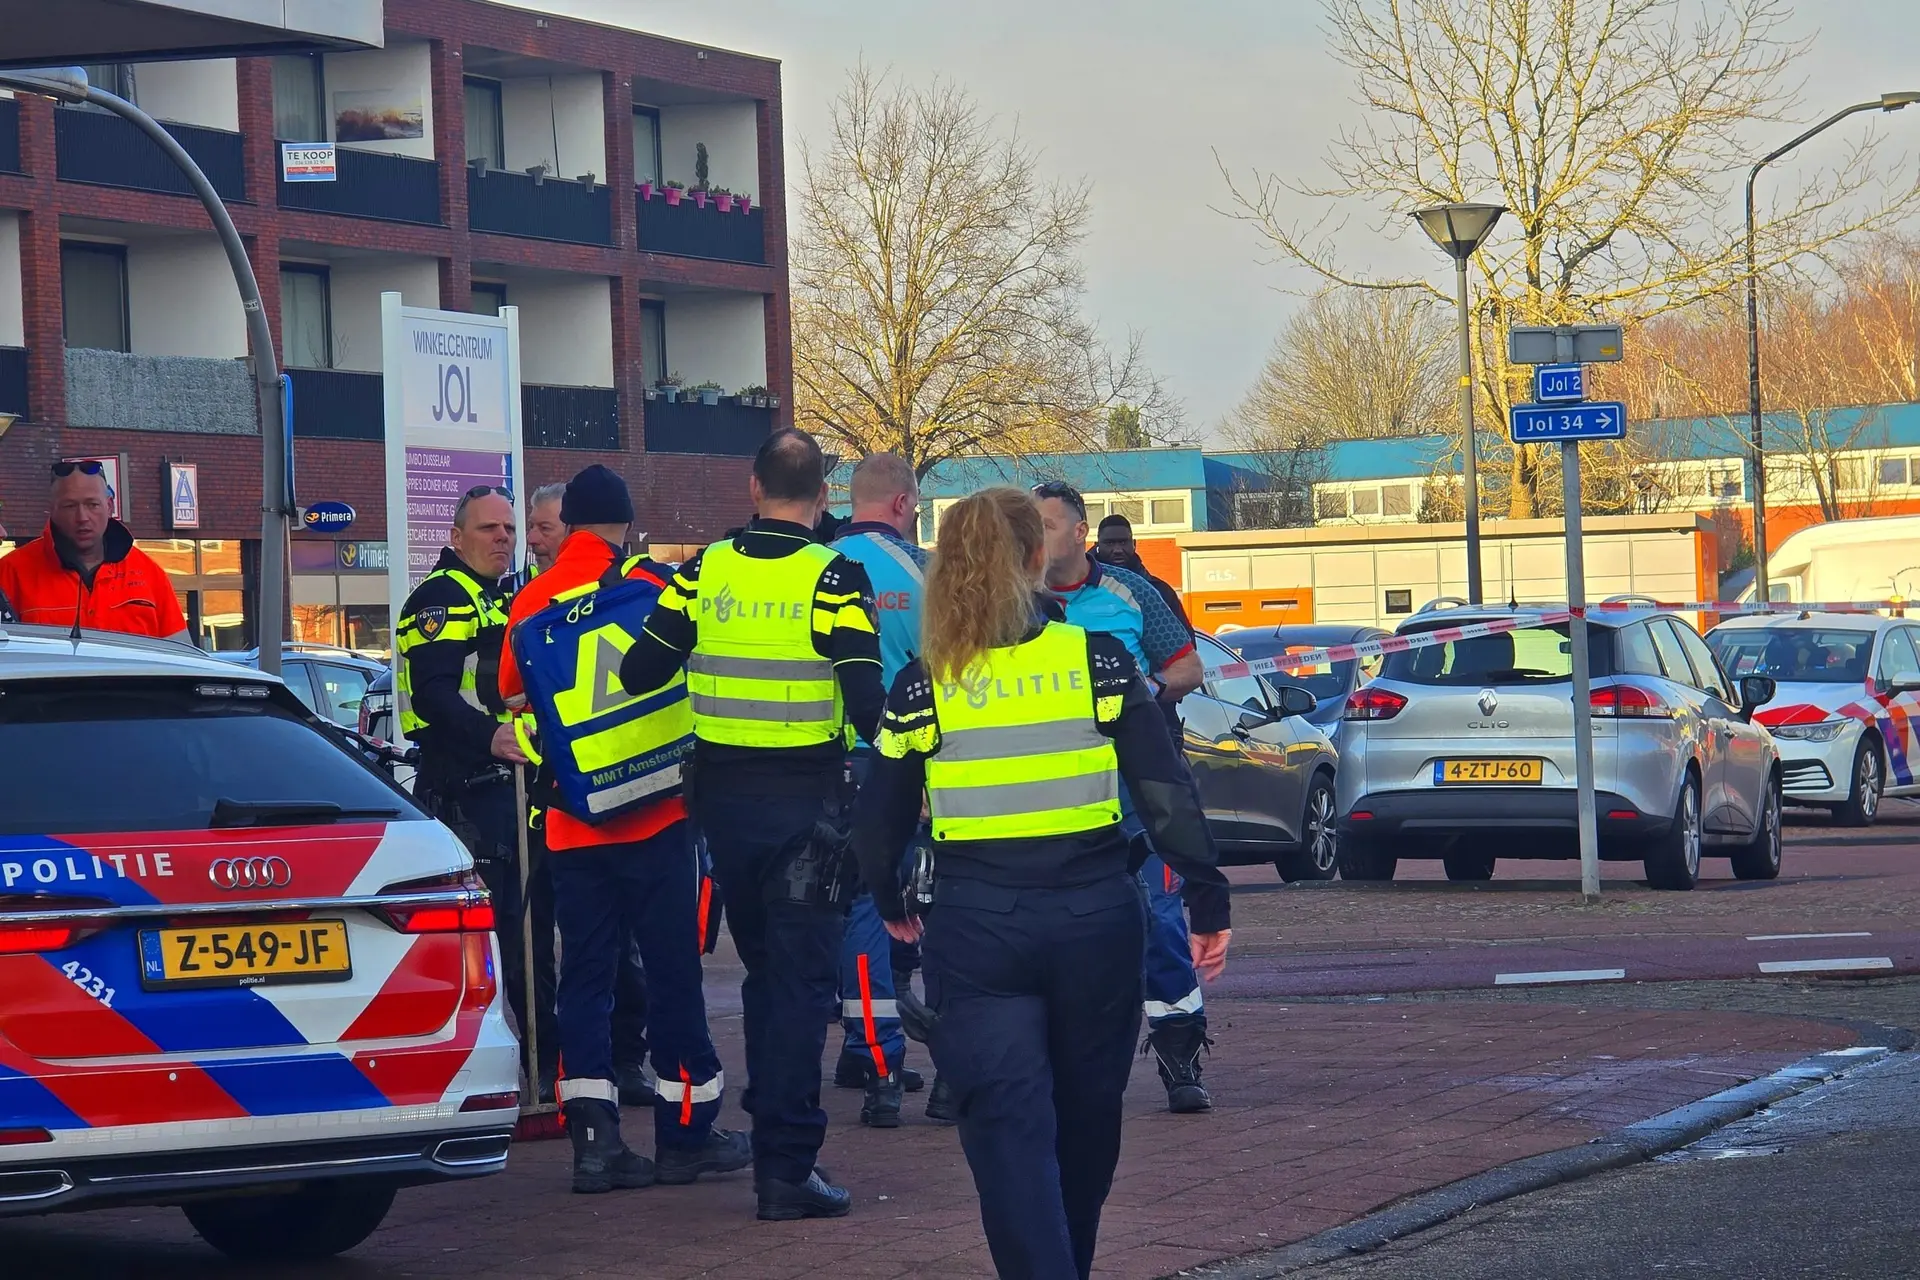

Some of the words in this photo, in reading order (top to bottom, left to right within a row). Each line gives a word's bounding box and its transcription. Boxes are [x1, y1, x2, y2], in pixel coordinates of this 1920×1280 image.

[286, 151, 300, 160] TE
[303, 151, 333, 160] KOOP
[412, 330, 493, 361] WINKELCENTRUM
[1546, 376, 1568, 392] Jol
[431, 363, 478, 424] JOL
[1526, 416, 1553, 432] Jol
[1560, 415, 1584, 430] 34
[441, 479, 459, 493] HOUSE
[176, 509, 194, 520] ALDI
[321, 511, 352, 523] Primera
[407, 502, 436, 516] ESTAURANT
[435, 503, 450, 517] ROSE
[427, 529, 435, 541] DE
[408, 552, 428, 566] IZZERIA
[701, 597, 805, 623] POLITIE
[942, 670, 1084, 709] POLITIE
[1467, 720, 1510, 729] CLIO
[592, 766, 624, 787] MMT
[1450, 762, 1532, 779] 4-ZTJ-60
[2, 852, 174, 888] POLITIE
[146, 960, 162, 973] NL
[176, 928, 329, 972] Z-549-JF
[61, 959, 117, 1009] 4231
[239, 975, 266, 986] politie.nl
